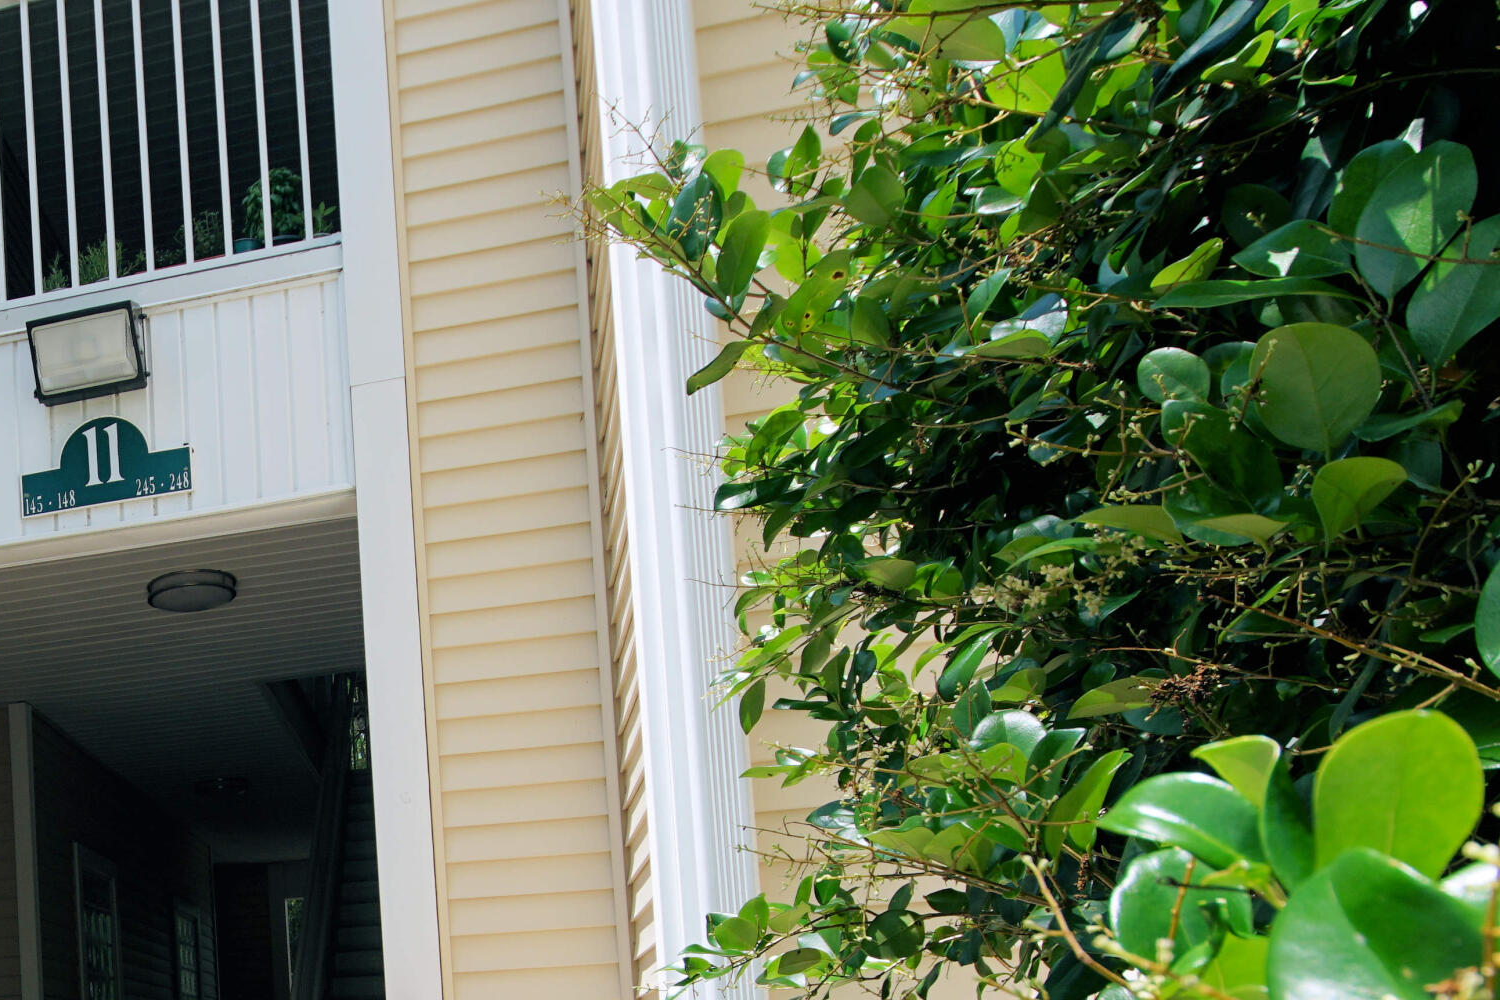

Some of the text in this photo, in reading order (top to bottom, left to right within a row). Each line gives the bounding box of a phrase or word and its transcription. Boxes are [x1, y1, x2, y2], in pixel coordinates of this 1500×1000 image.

[82, 423, 125, 487] 11
[135, 471, 190, 496] 245 248
[25, 490, 76, 515] 145 148
